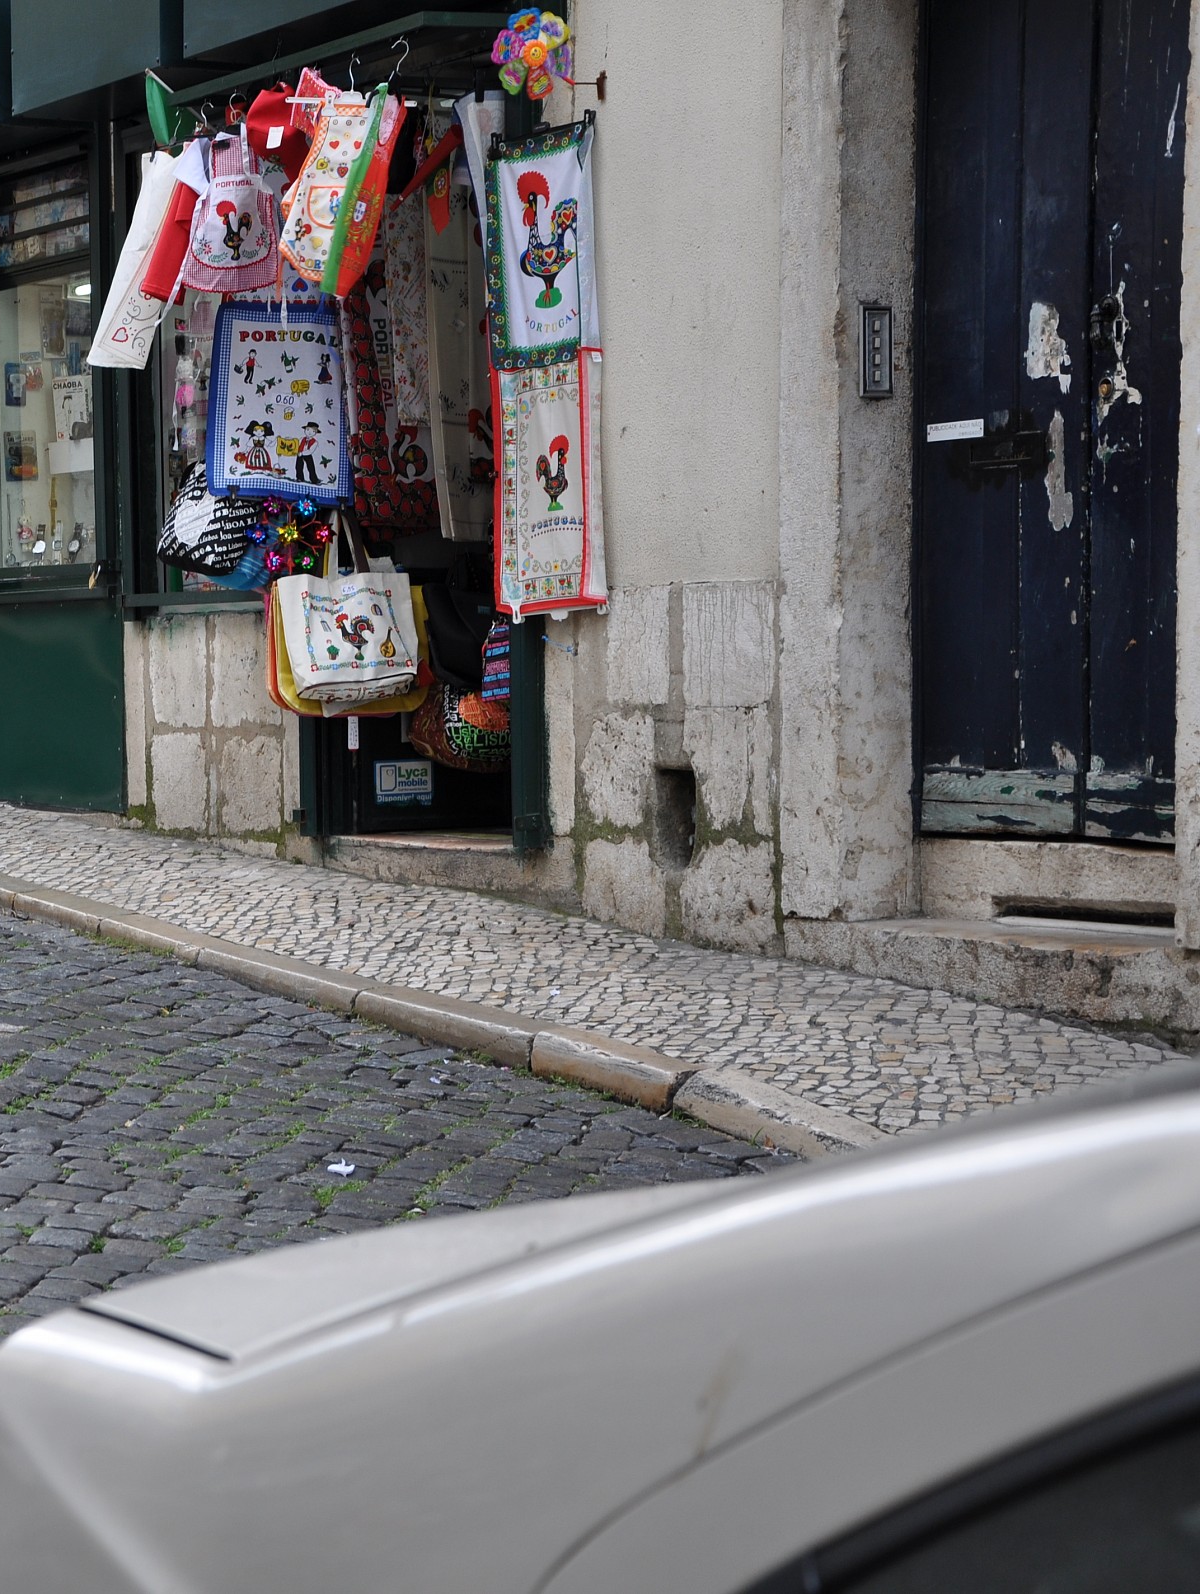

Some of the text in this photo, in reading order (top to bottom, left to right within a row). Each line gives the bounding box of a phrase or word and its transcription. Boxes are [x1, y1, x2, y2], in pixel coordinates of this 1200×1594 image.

[215, 180, 254, 188] PORTUGAL
[239, 330, 338, 348] PORTUGAL
[373, 318, 394, 412] PORTUGAL
[53, 381, 82, 390] CHAOBA
[531, 516, 584, 532] PORTUGAL
[397, 766, 428, 780] Lyca
[397, 778, 428, 788] mobile
